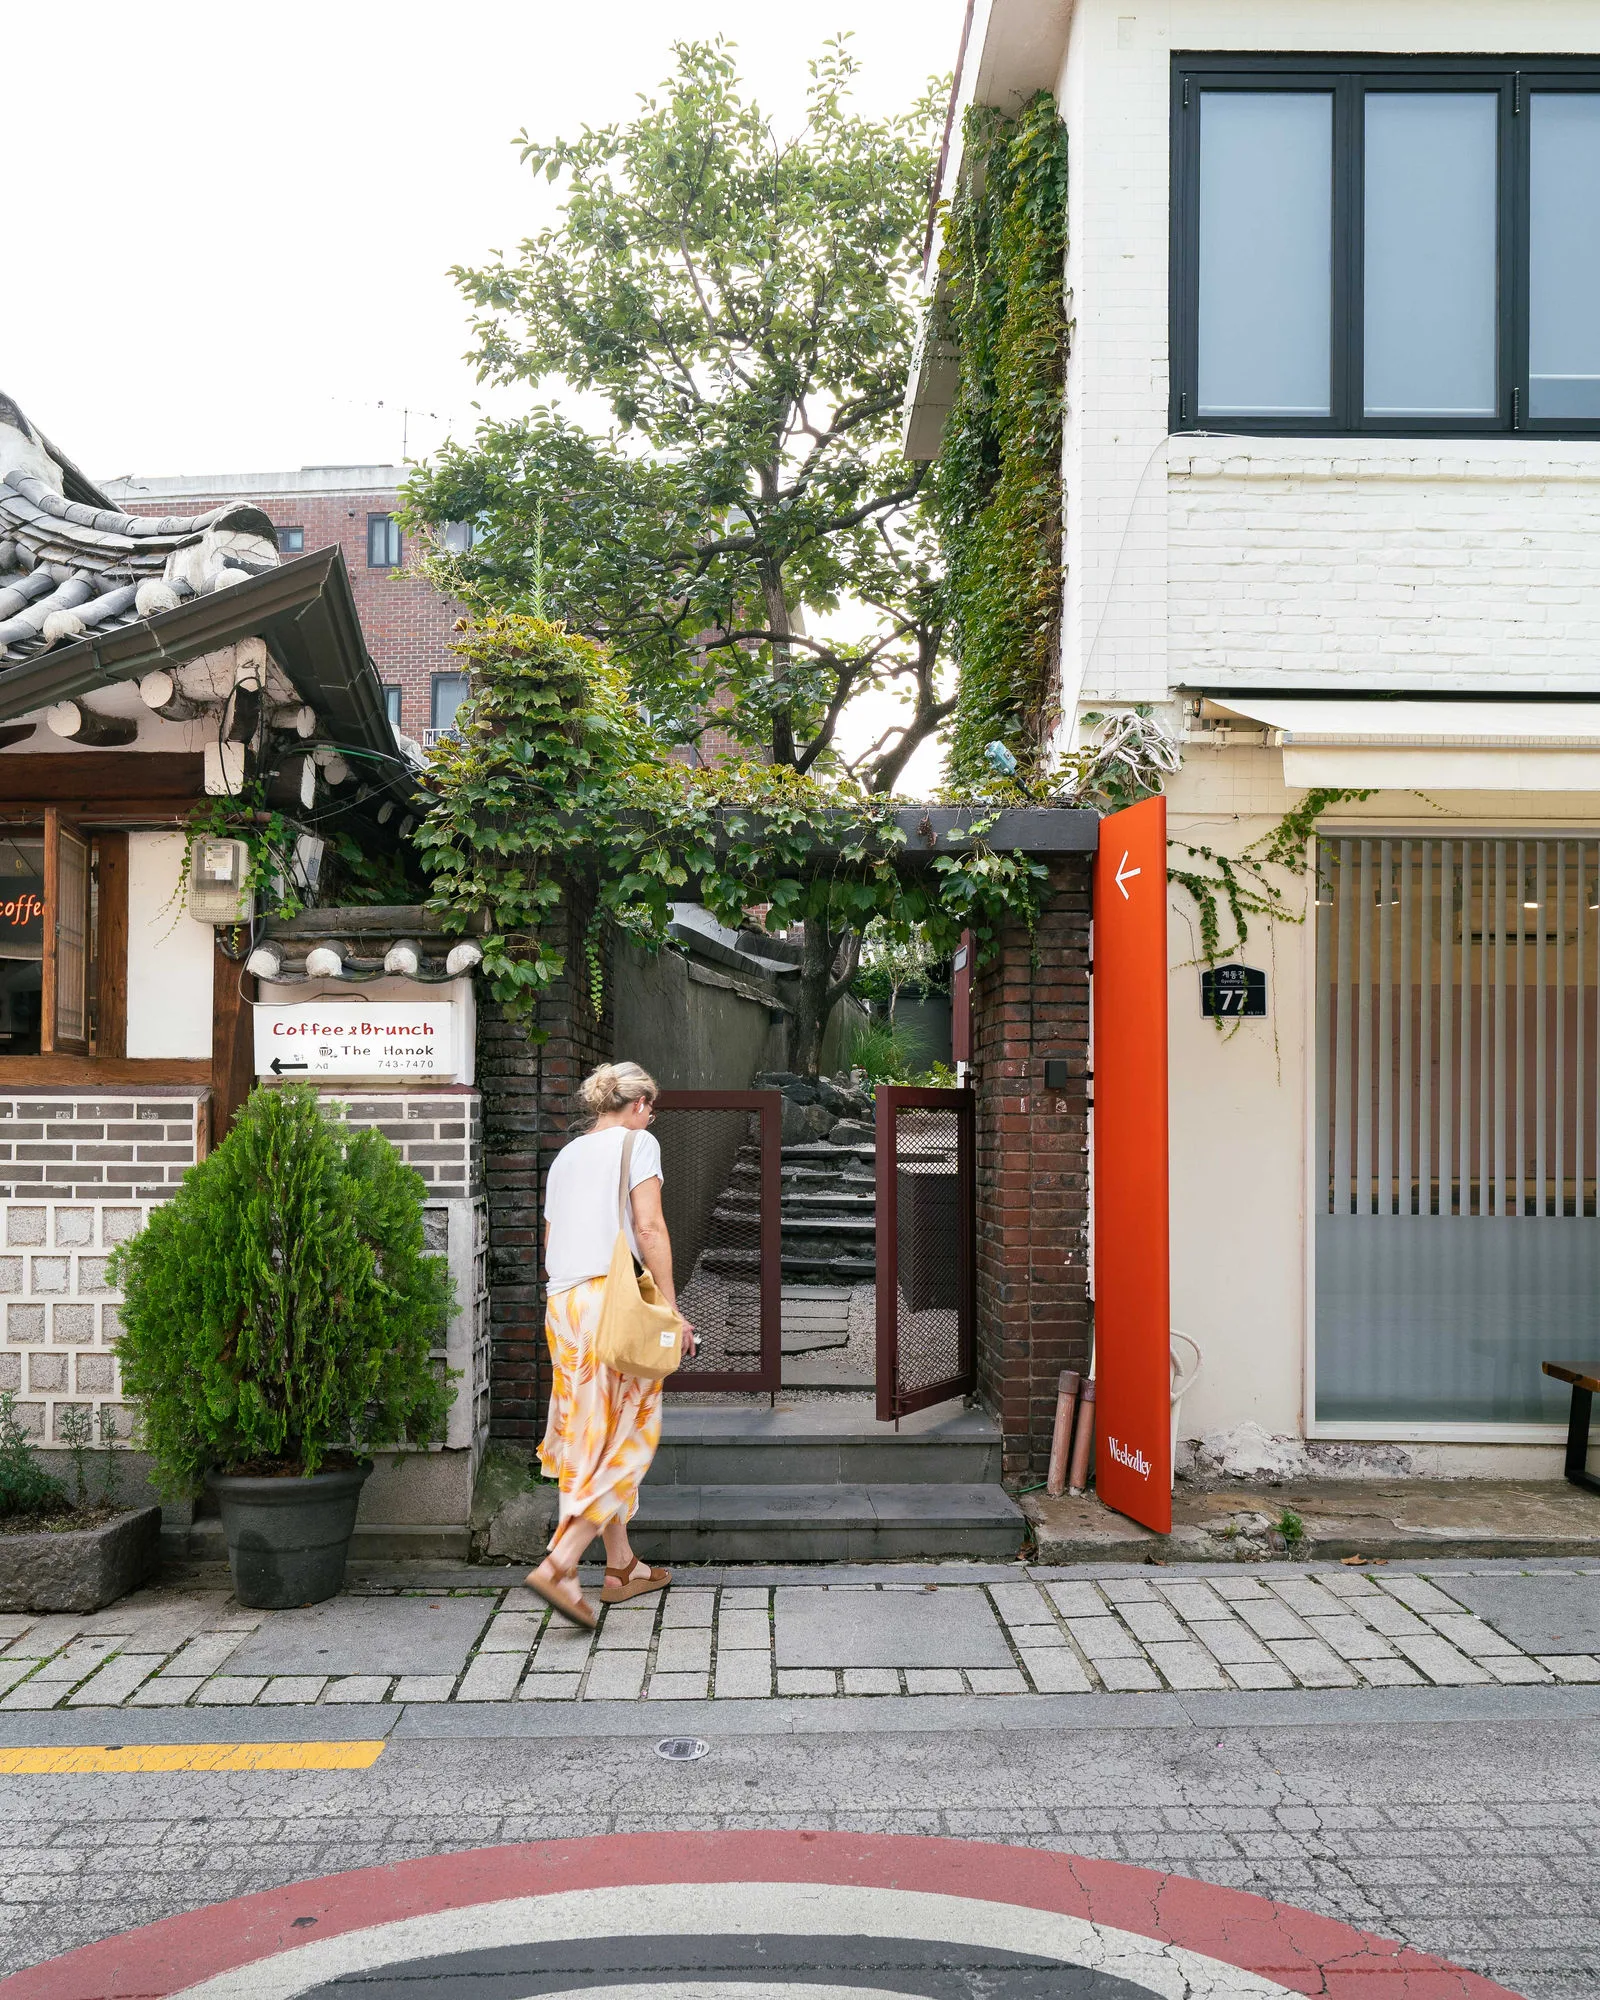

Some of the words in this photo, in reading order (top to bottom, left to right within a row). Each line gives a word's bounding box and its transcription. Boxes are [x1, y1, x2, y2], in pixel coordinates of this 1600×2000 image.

[0, 894, 45, 925] offe
[1222, 970, 1245, 979] 계동길
[1220, 990, 1248, 1010] 77
[340, 1045, 371, 1056] The
[384, 1045, 434, 1056] Hanok
[378, 1060, 434, 1068] 743-7470
[1108, 1436, 1153, 1482] Weekalley
